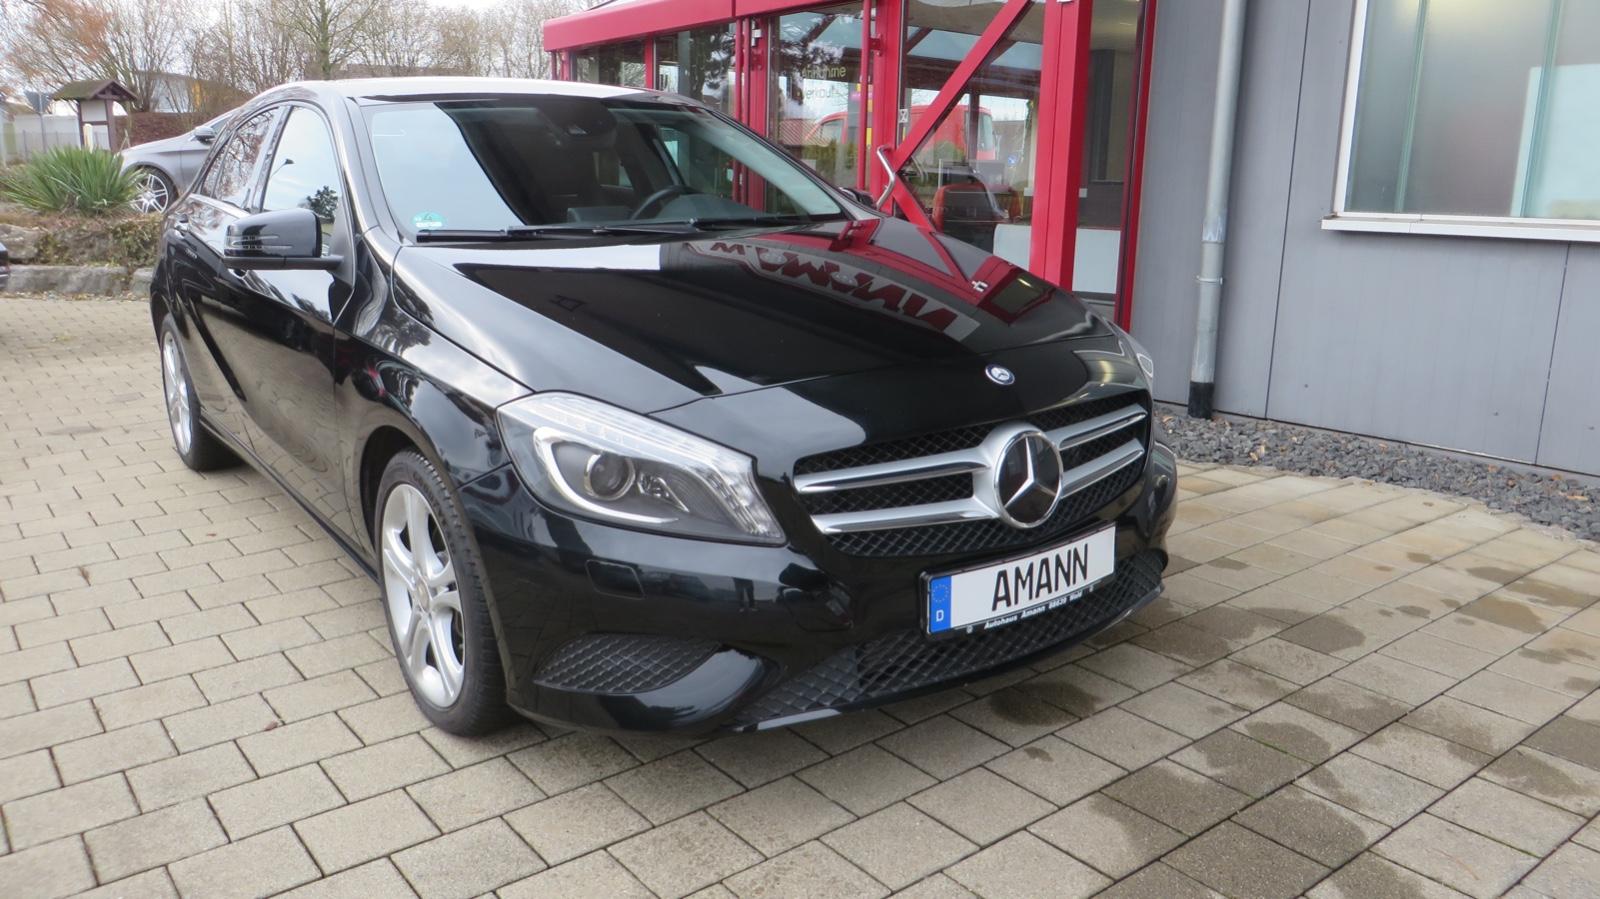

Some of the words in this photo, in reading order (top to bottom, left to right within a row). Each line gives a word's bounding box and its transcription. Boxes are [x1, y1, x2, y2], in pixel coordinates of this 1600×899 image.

[992, 543, 1088, 611] AMANN
[936, 609, 945, 622] D
[984, 614, 1018, 630] Autohaus
[1020, 605, 1046, 619] Amann
